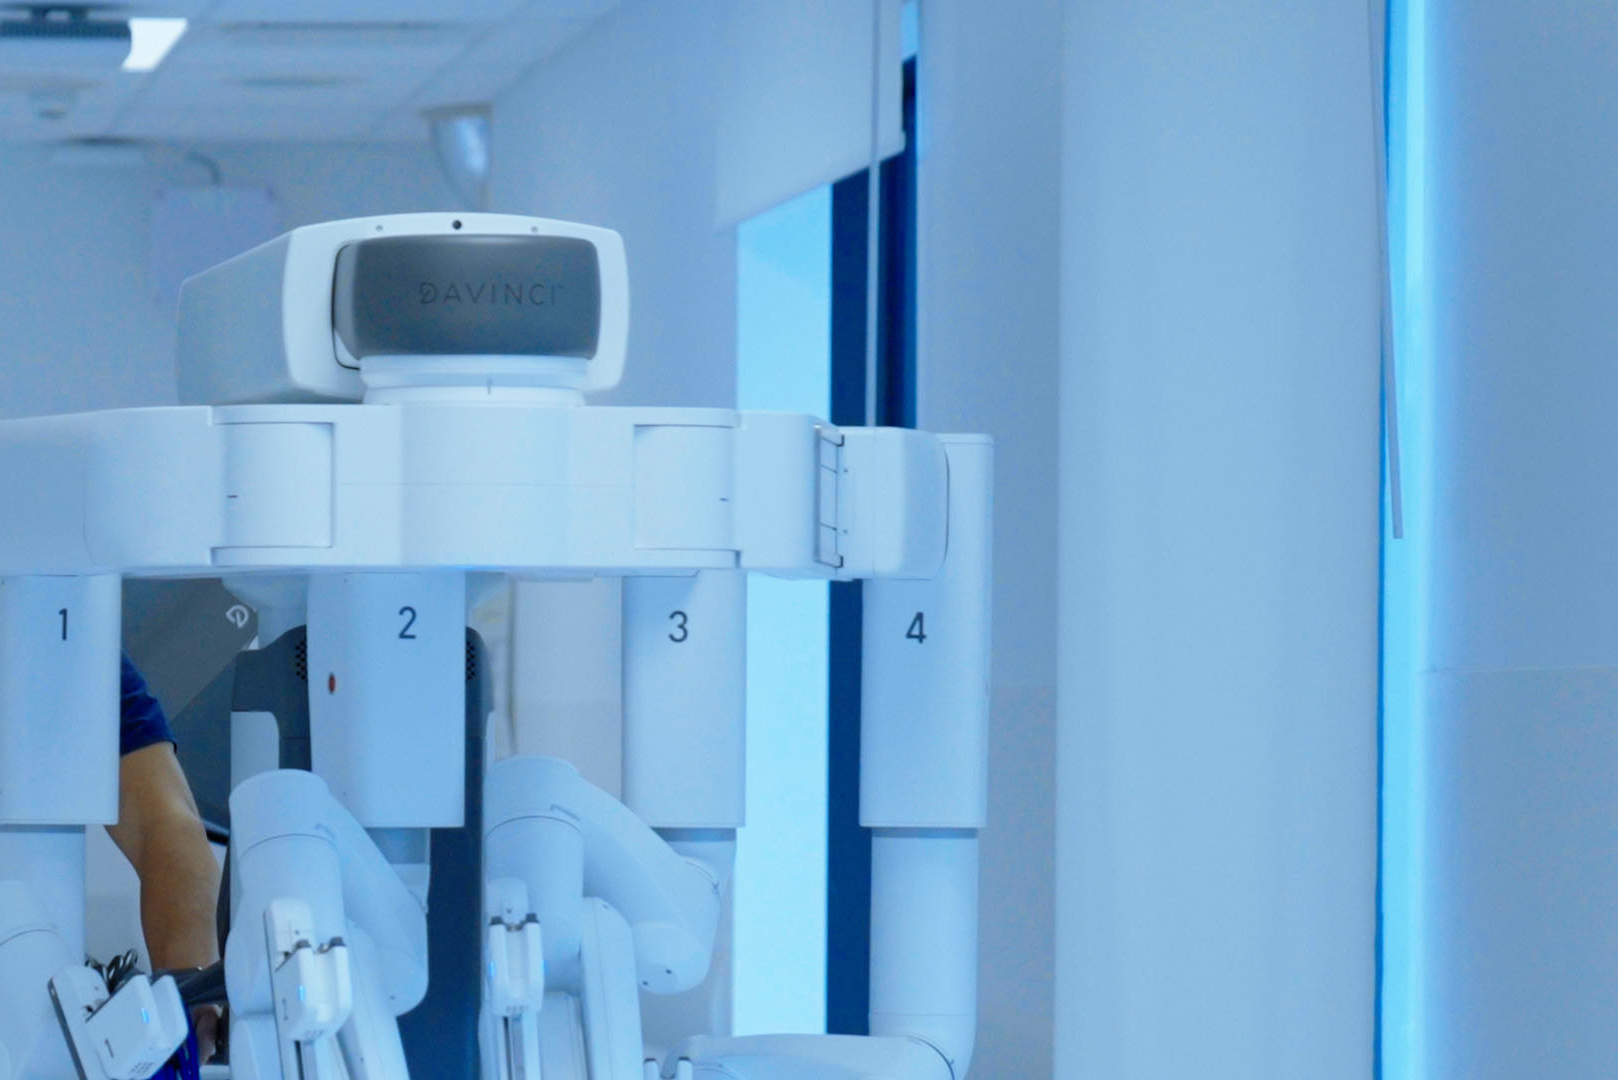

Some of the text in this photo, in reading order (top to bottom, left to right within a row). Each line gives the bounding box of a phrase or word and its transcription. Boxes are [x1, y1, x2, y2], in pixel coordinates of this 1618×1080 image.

[58, 607, 69, 641] 1
[397, 606, 417, 640] 2
[668, 610, 689, 643] 3
[905, 612, 928, 644] 4
